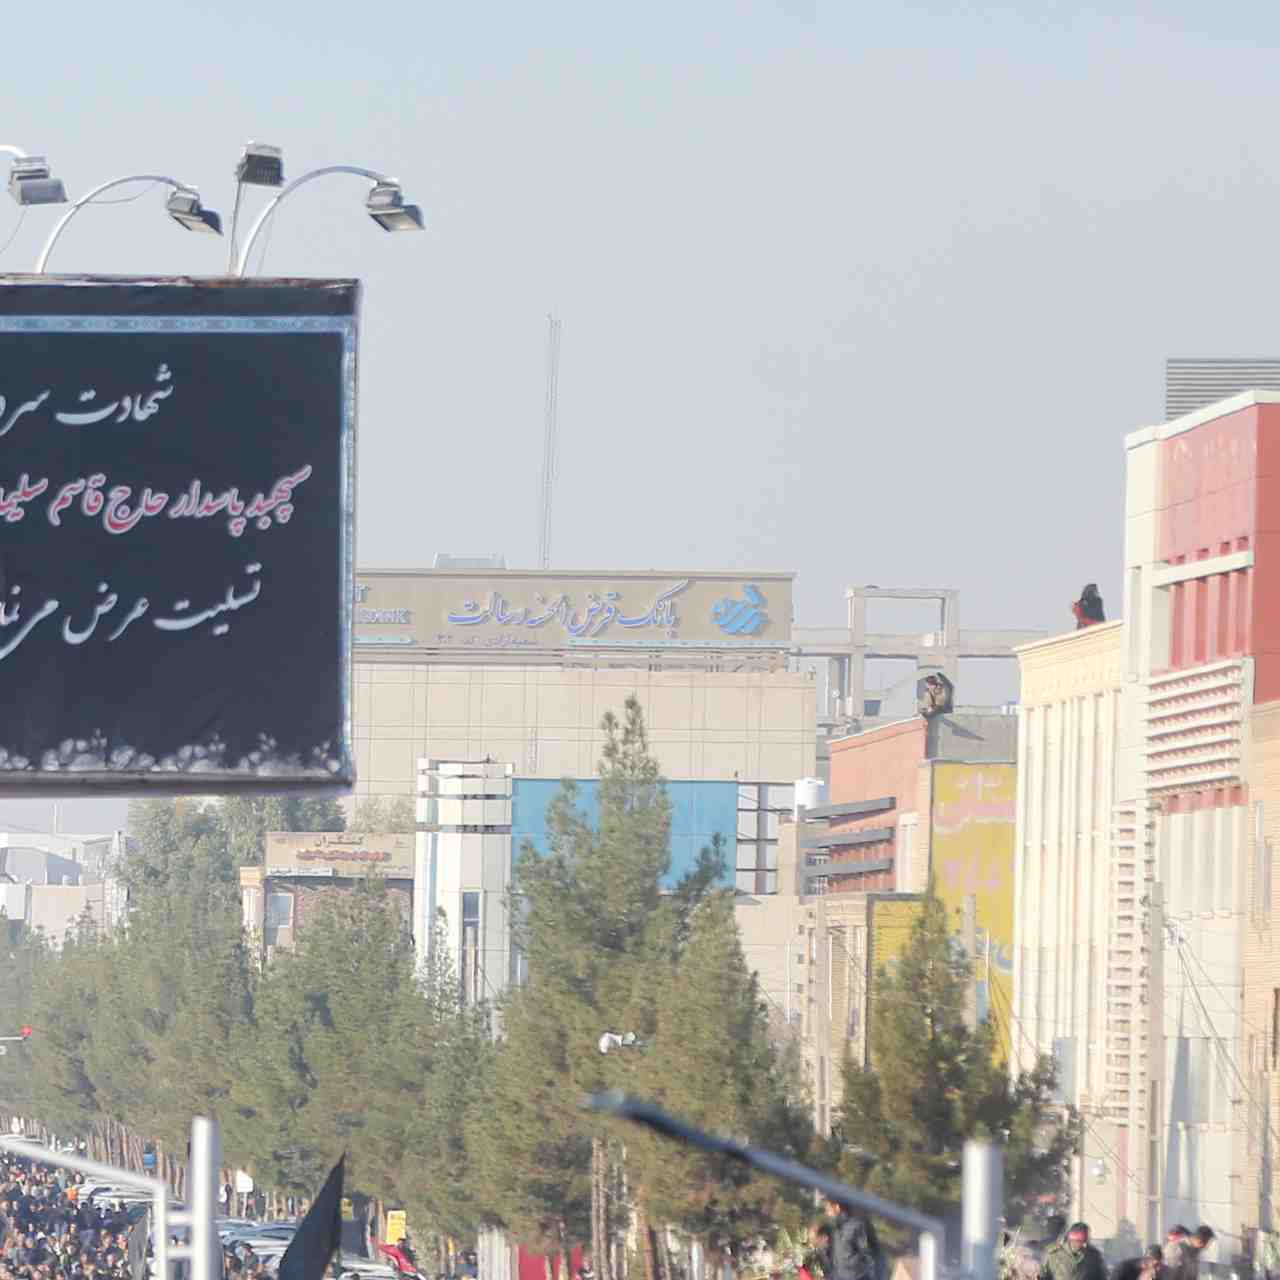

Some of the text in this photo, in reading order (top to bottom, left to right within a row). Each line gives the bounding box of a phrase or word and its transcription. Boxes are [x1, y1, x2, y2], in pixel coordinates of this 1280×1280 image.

[55, 363, 175, 426] شهادت
[48, 472, 107, 528] قاسم
[103, 484, 171, 535] حاج
[168, 480, 246, 537] پاسدار
[245, 464, 313, 530] سپهبد
[61, 581, 151, 644] عرض
[152, 561, 263, 636] تسلیت
[617, 577, 689, 640] بانک
